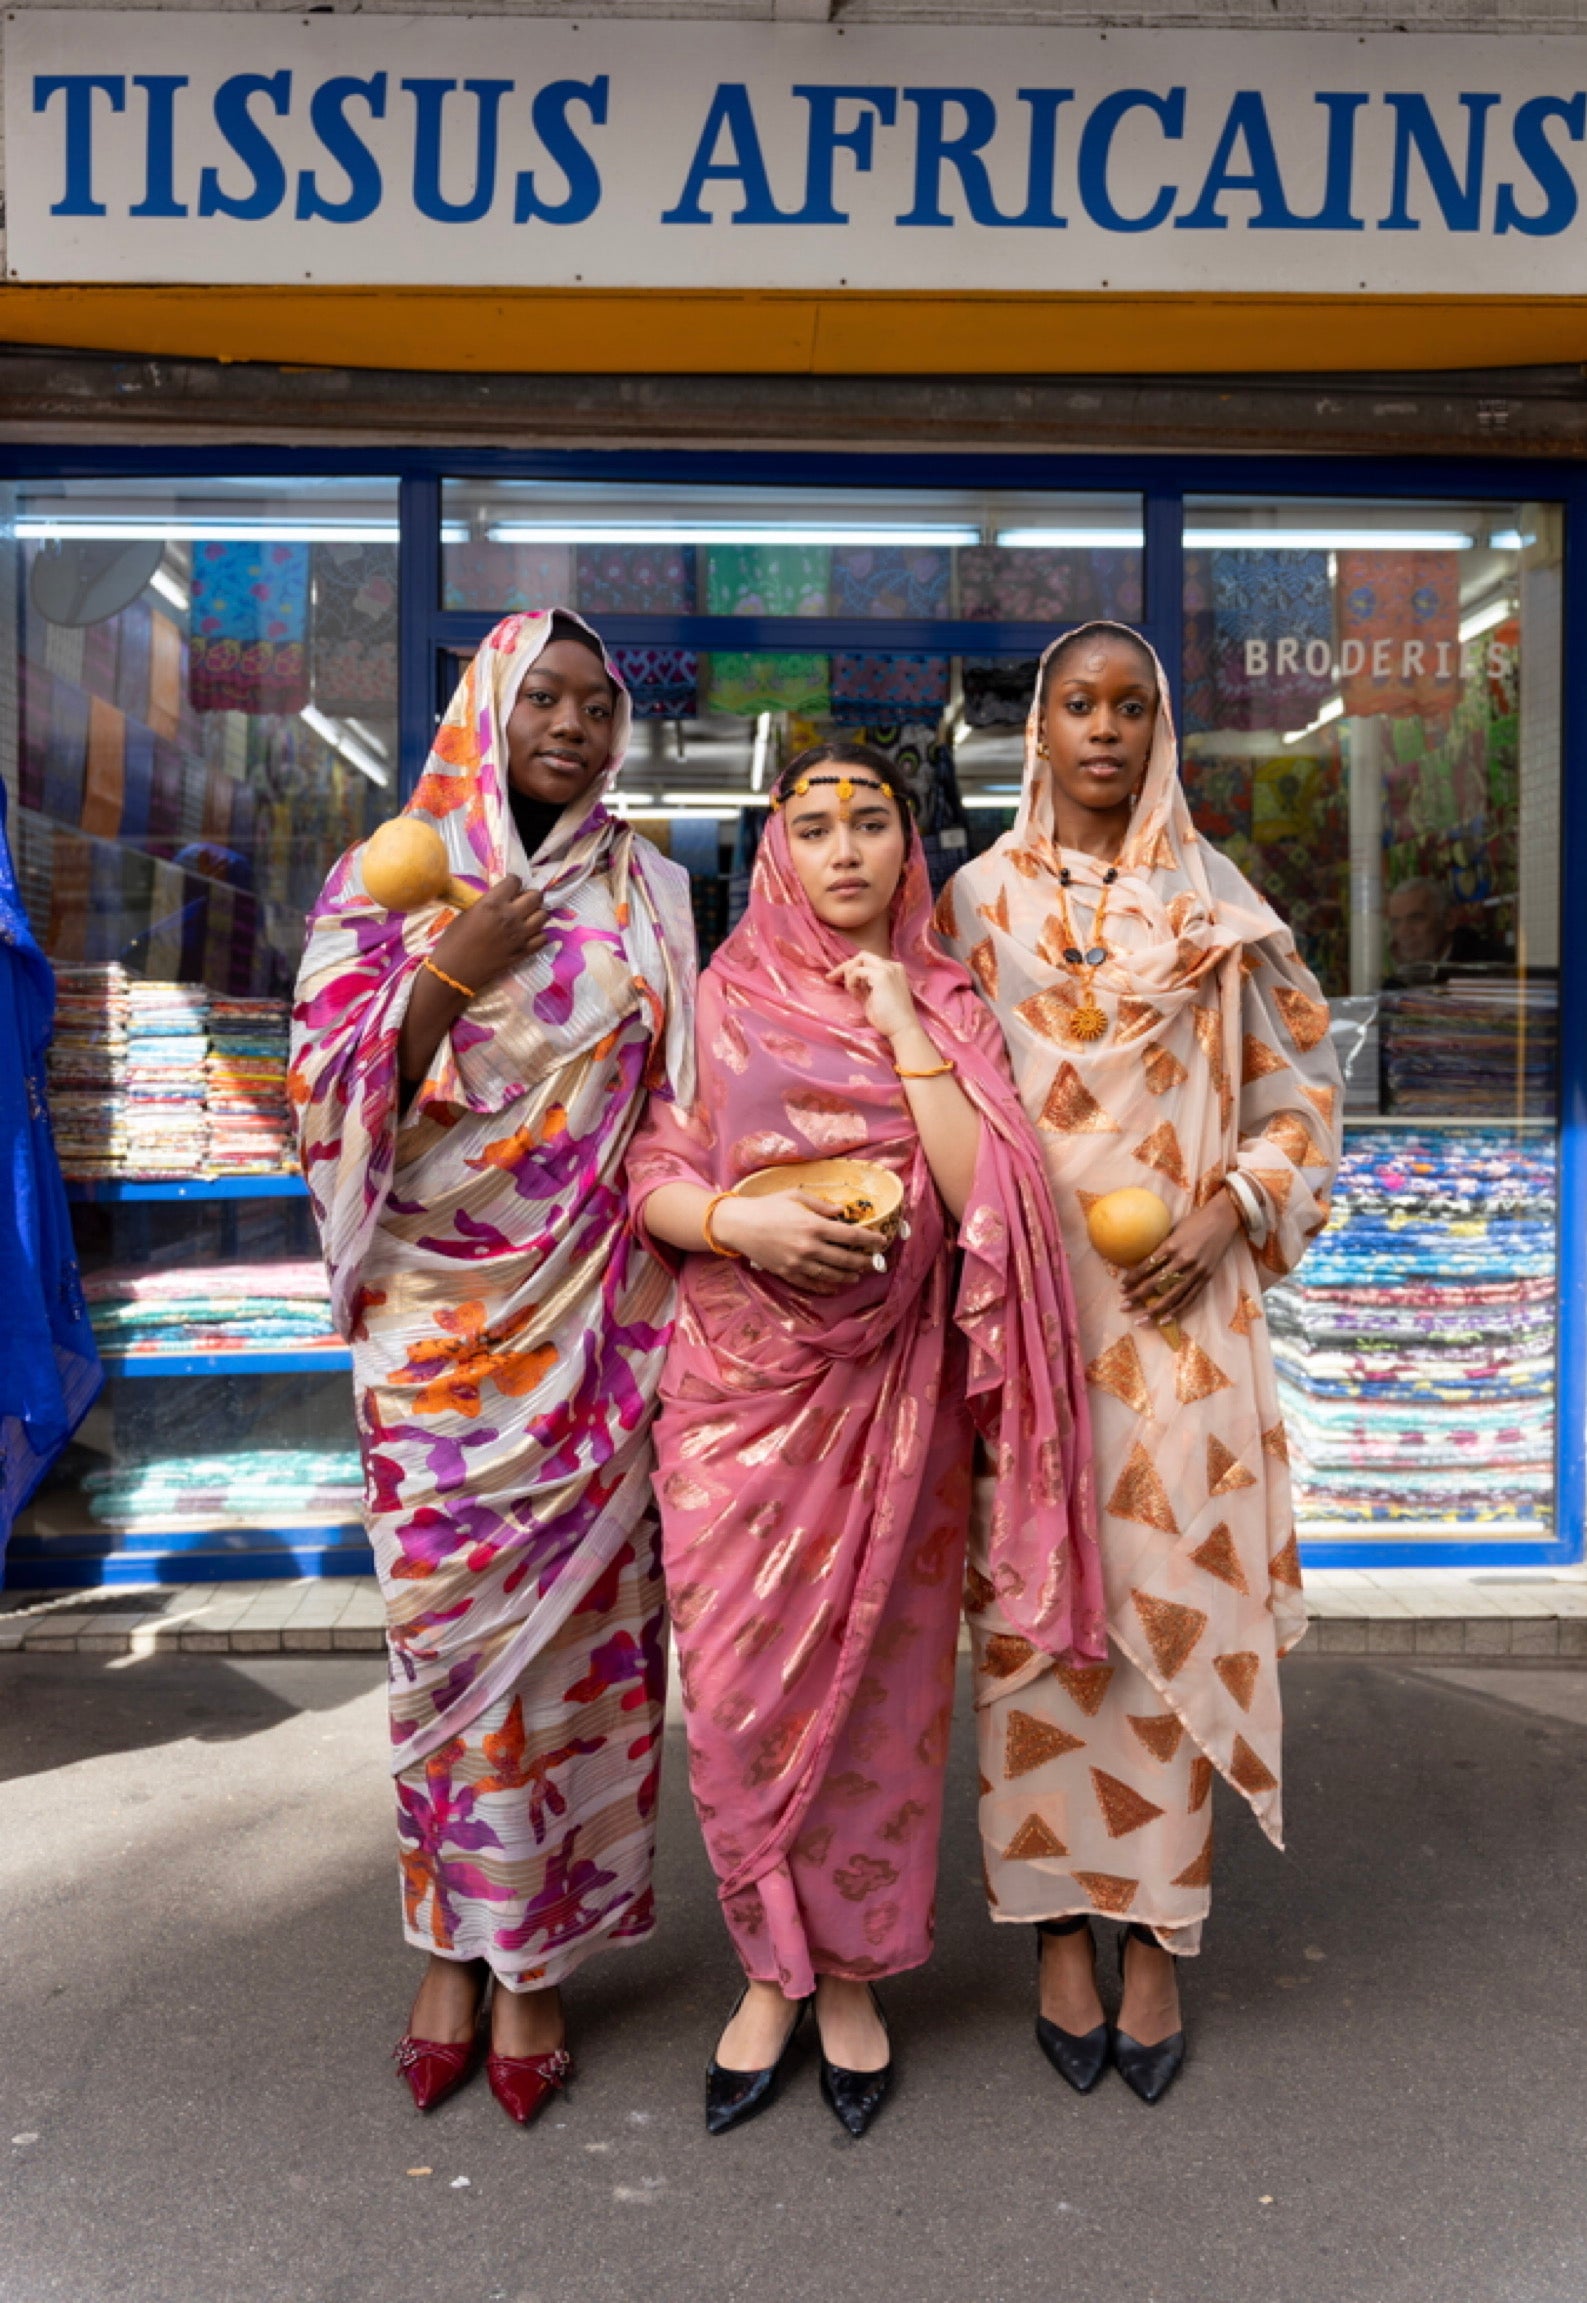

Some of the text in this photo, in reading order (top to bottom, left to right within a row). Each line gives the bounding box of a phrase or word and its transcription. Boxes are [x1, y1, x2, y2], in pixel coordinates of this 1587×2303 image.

[33, 69, 1587, 237] TISSUS AFRICAINS
[1244, 638, 1511, 679] BRODERIES
